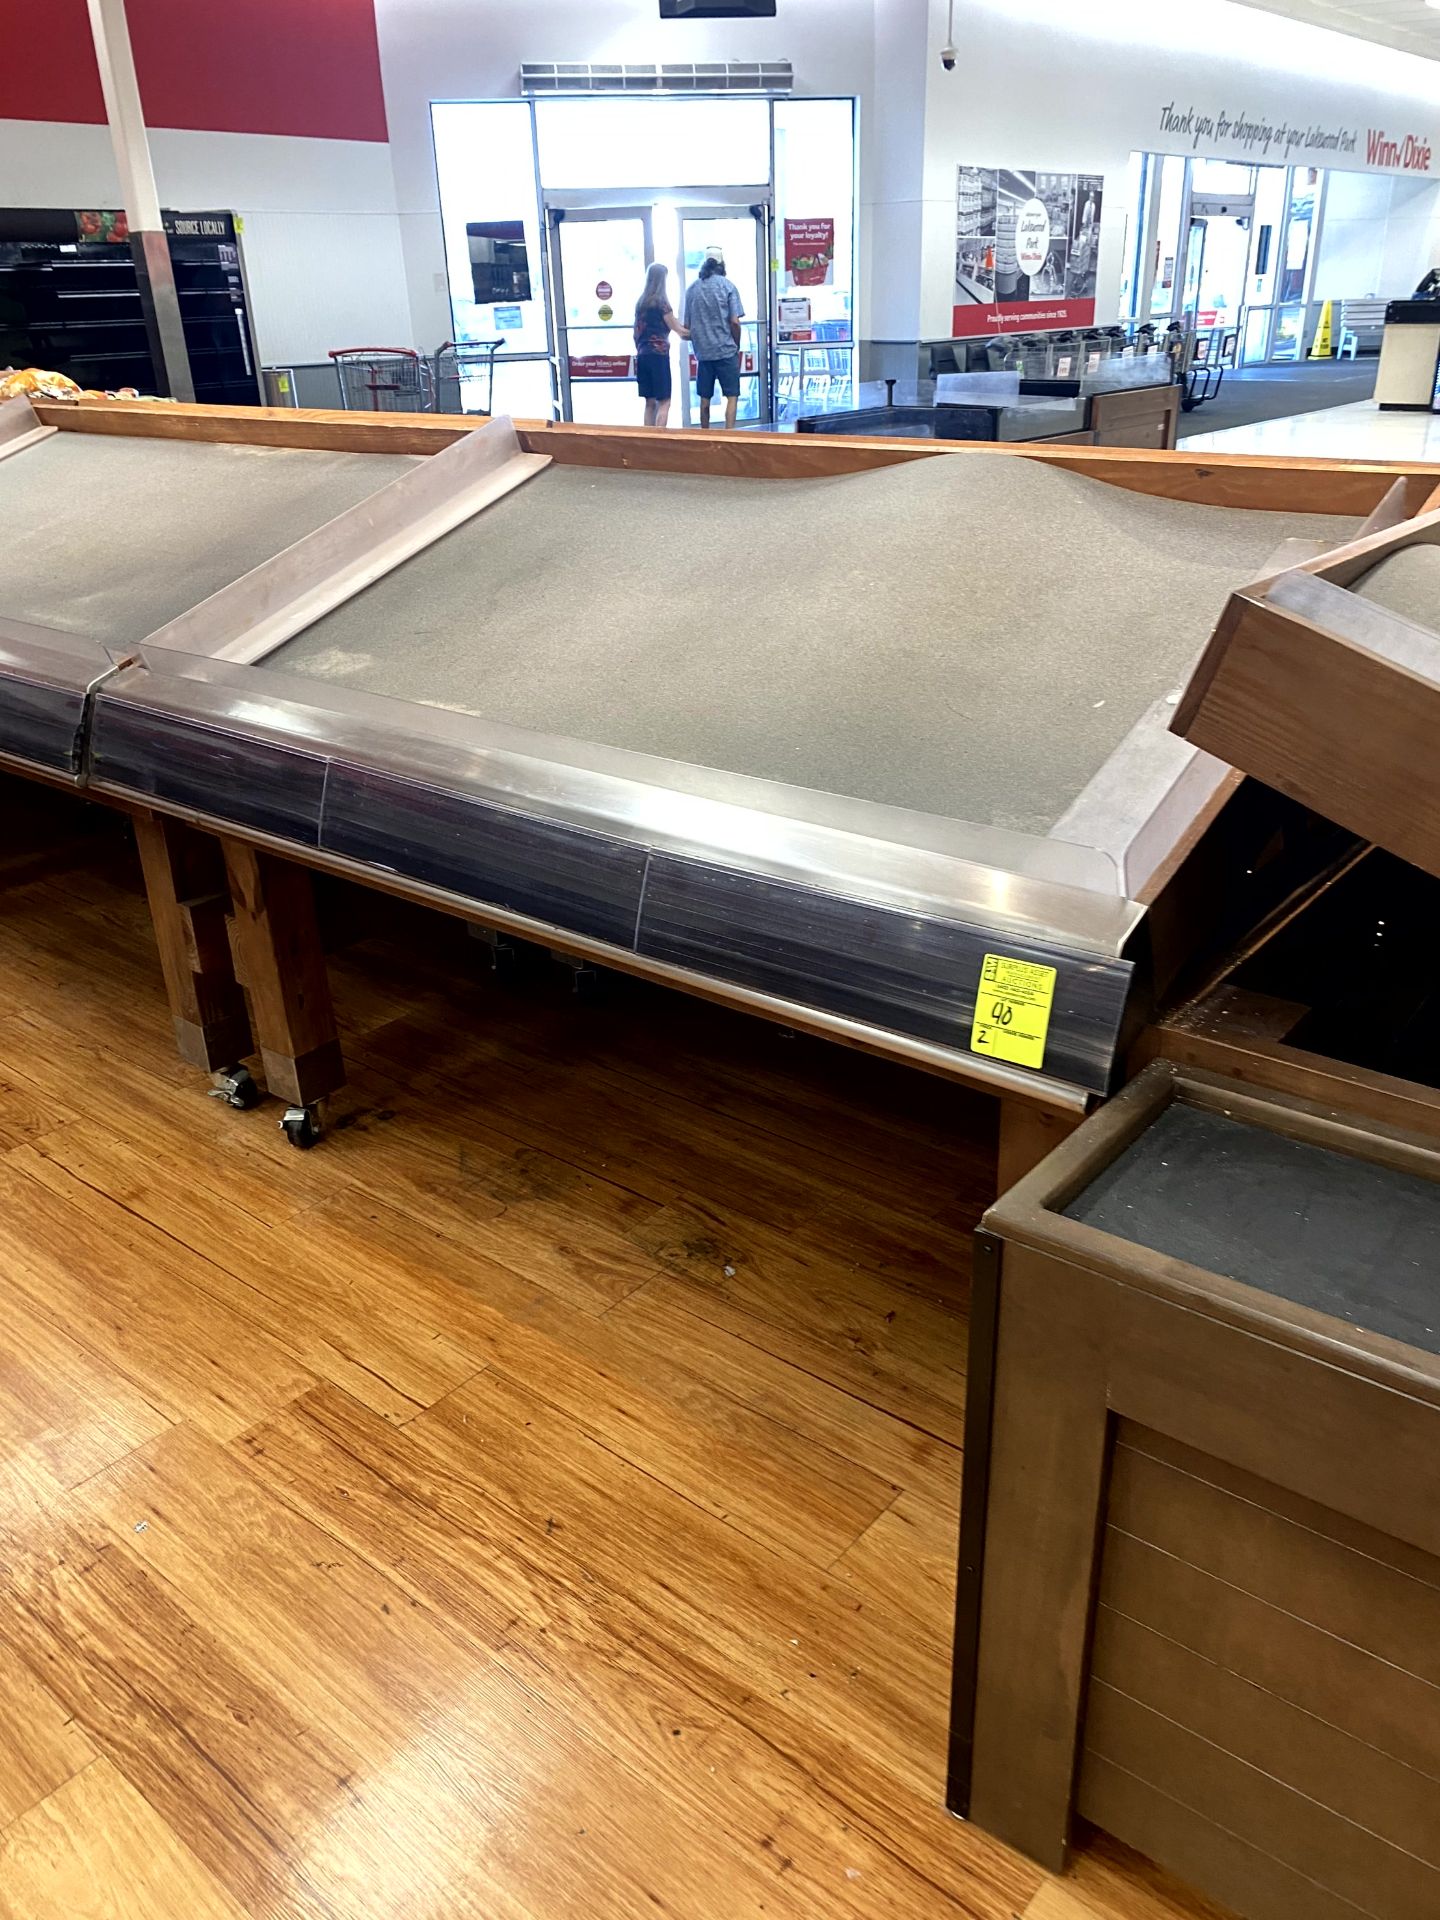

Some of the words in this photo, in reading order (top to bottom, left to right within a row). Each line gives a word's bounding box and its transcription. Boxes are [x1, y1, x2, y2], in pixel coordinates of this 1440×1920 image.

[1159, 100, 1194, 135] Thank
[1194, 116, 1215, 149] you
[1214, 110, 1232, 142] for
[1231, 110, 1272, 155] shopping
[1273, 122, 1287, 145] at
[1286, 128, 1305, 159] your
[174, 219, 200, 235] SOURCE
[200, 219, 225, 235] LOCALLY
[820, 222, 831, 230] for
[805, 231, 828, 240] loyalty!
[987, 314, 1004, 324] Proudly
[1003, 312, 1020, 323] serving
[1020, 310, 1046, 321] communities
[1046, 310, 1057, 319] since
[1003, 976, 1043, 991] AUCTIONS
[991, 1001, 1013, 1026] 40
[977, 1030, 990, 1044] 2
